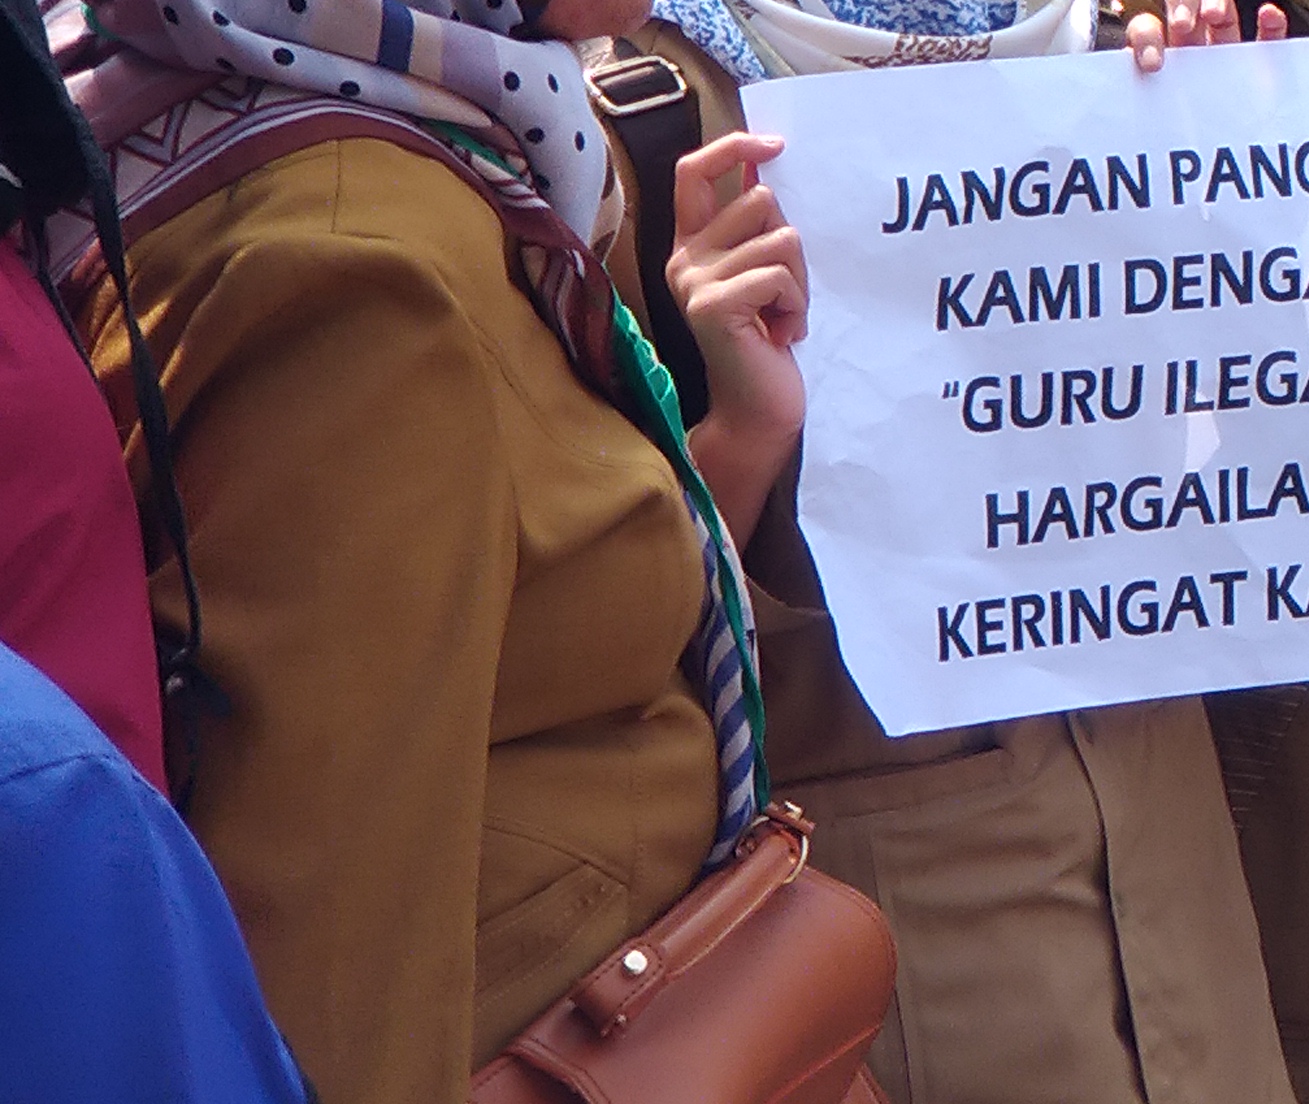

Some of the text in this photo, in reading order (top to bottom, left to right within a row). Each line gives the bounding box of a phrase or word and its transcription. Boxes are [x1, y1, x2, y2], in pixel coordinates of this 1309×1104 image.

[881, 153, 1152, 234] JANGAN
[936, 262, 1101, 332] KAMI
[937, 570, 1248, 662] KERINGAT
